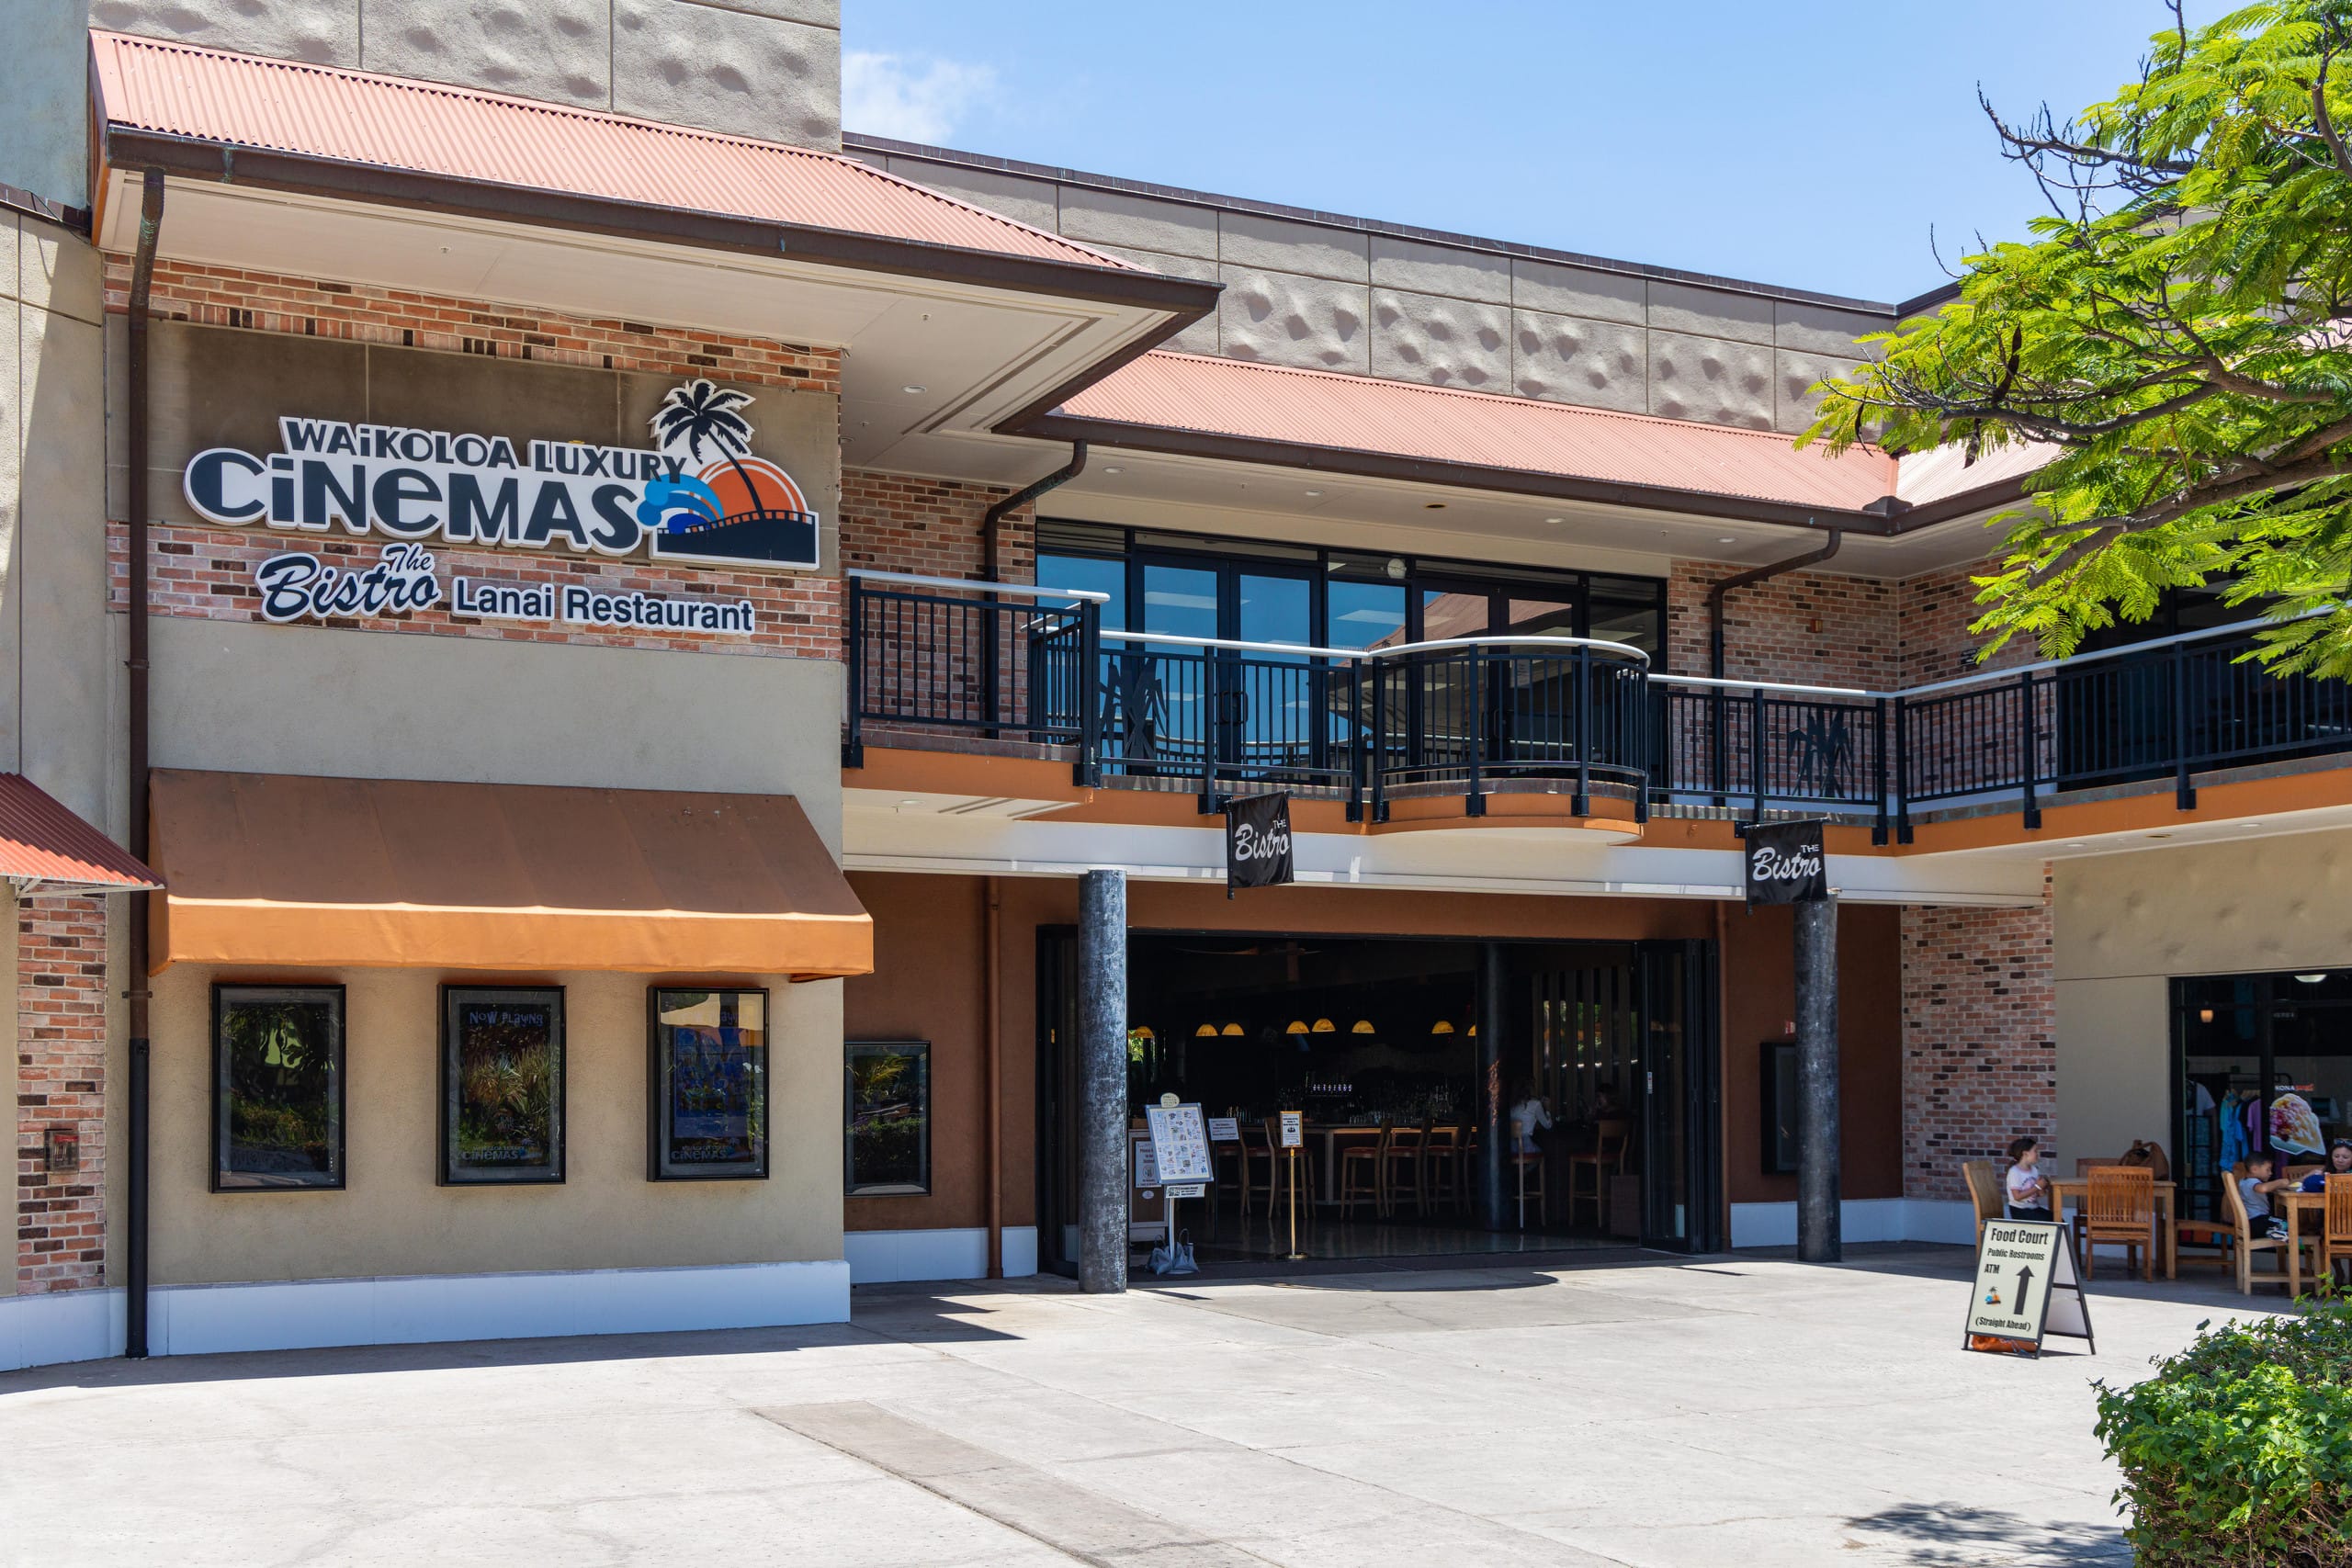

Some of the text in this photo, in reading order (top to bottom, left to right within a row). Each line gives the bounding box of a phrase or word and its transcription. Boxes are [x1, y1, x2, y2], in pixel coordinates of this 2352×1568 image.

[535, 444, 687, 484] LUXURY
[385, 546, 432, 572] The
[259, 556, 439, 617] Bistro
[457, 580, 752, 631] Lanai Restaurant
[1272, 818, 1287, 829] THE
[1234, 823, 1290, 862] Bistro
[1801, 843, 1820, 853] THE
[1752, 846, 1822, 881] Bistro
[1991, 1227, 2049, 1246] Food Court
[1986, 1247, 2045, 1261] Public Restrooms
[1984, 1263, 2000, 1275] ATM
[1975, 1316, 2031, 1332] (Straight Ahead)
